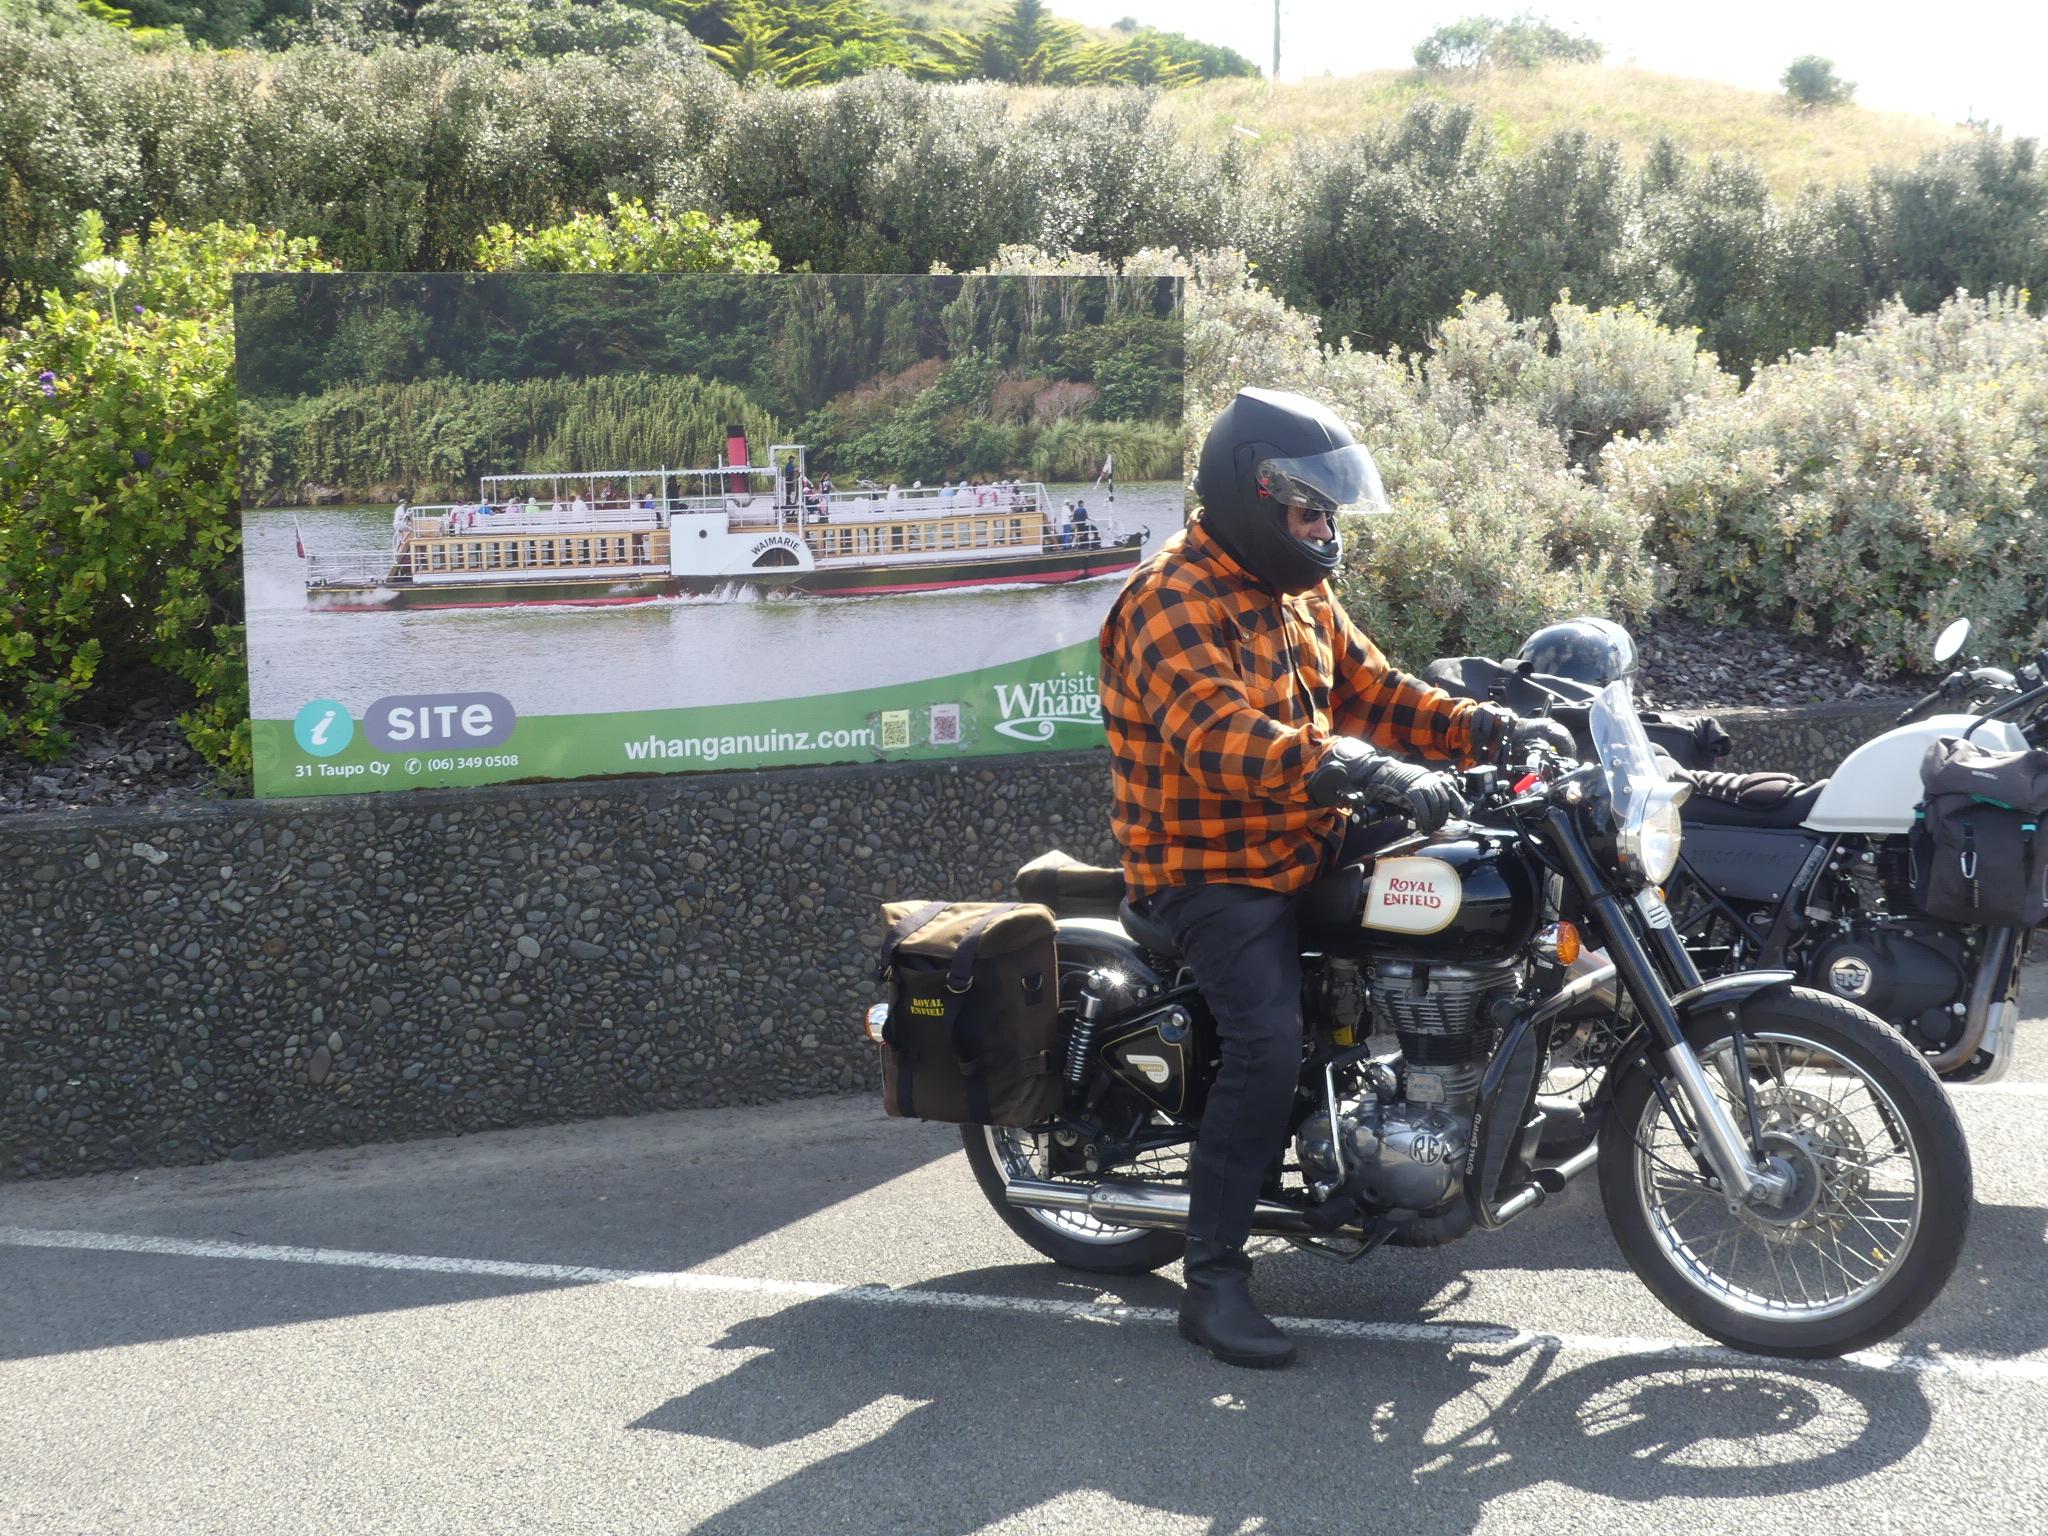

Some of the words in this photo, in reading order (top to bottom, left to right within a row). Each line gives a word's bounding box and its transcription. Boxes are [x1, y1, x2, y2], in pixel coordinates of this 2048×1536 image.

[751, 536, 801, 556] WAIMARIE
[1047, 670, 1095, 694] visit
[624, 728, 875, 761] whanganuinz.com
[295, 765, 313, 777] 31
[318, 763, 364, 778] Taupo
[369, 761, 391, 776] Qy
[428, 758, 454, 772] (06)
[457, 756, 482, 769] 349
[485, 755, 519, 767] 0508
[1389, 878, 1435, 893] ROYAL
[1383, 893, 1442, 909] ENFIELD
[912, 998, 943, 1007] ROYAL
[1465, 1149, 1476, 1175] ROYAL
